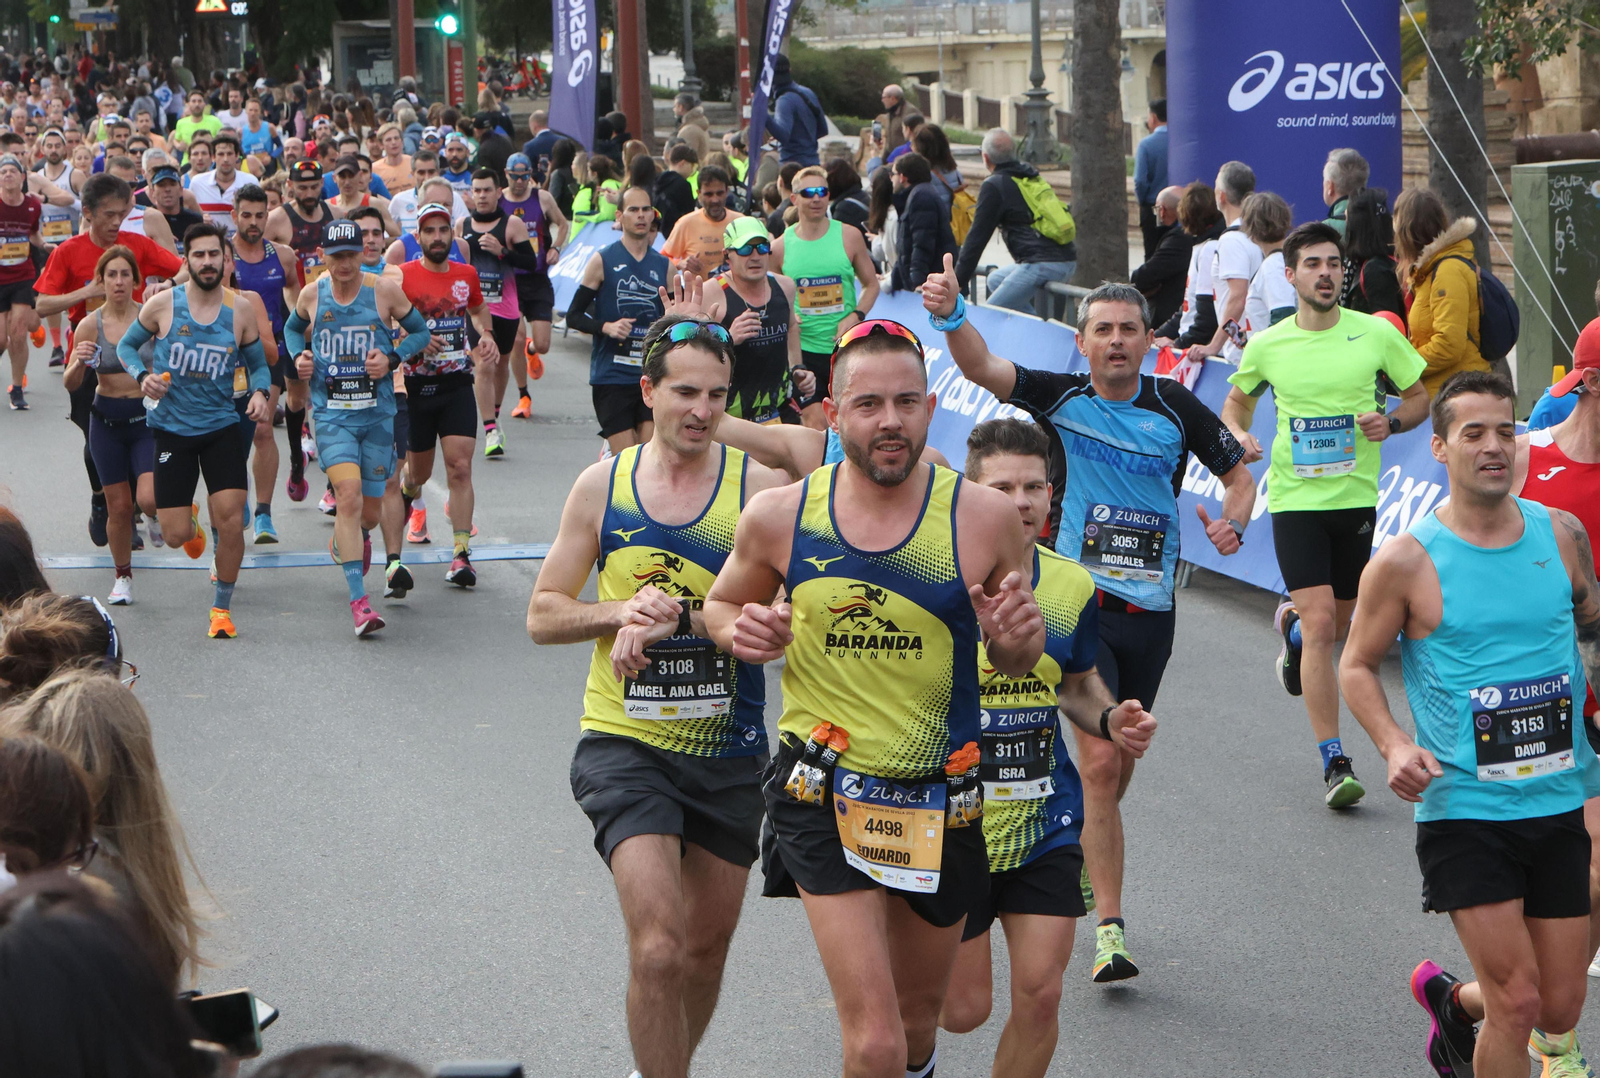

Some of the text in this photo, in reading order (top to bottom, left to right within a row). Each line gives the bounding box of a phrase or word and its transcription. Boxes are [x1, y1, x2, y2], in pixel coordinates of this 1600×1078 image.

[1284, 62, 1385, 101] asics
[1276, 112, 1397, 128] sound mind, sound body
[812, 277, 837, 285] ZURICH
[341, 381, 360, 389] 2034
[351, 391, 372, 399] SERGIO
[1309, 418, 1346, 429] ZURICH
[1307, 438, 1336, 449] 12305
[1115, 510, 1159, 526] ZURICH
[1111, 534, 1139, 549] 3053
[1101, 553, 1144, 568] MORALES
[825, 632, 923, 651] BARANDA
[824, 648, 923, 660] RUNNING
[658, 659, 694, 675] 3108
[628, 682, 728, 698] ÁNGEL ANA GAEL
[979, 680, 1051, 696] BARANDA
[1508, 680, 1561, 701] ZURICH
[997, 711, 1048, 726] ZURICH
[1511, 715, 1545, 735] 3153
[995, 741, 1025, 758] 3117
[1514, 741, 1547, 758] DAVID
[998, 767, 1026, 780] ISRA
[869, 786, 931, 804] ZURICH
[864, 818, 903, 837] 4498
[857, 844, 911, 865] EDUARDO
